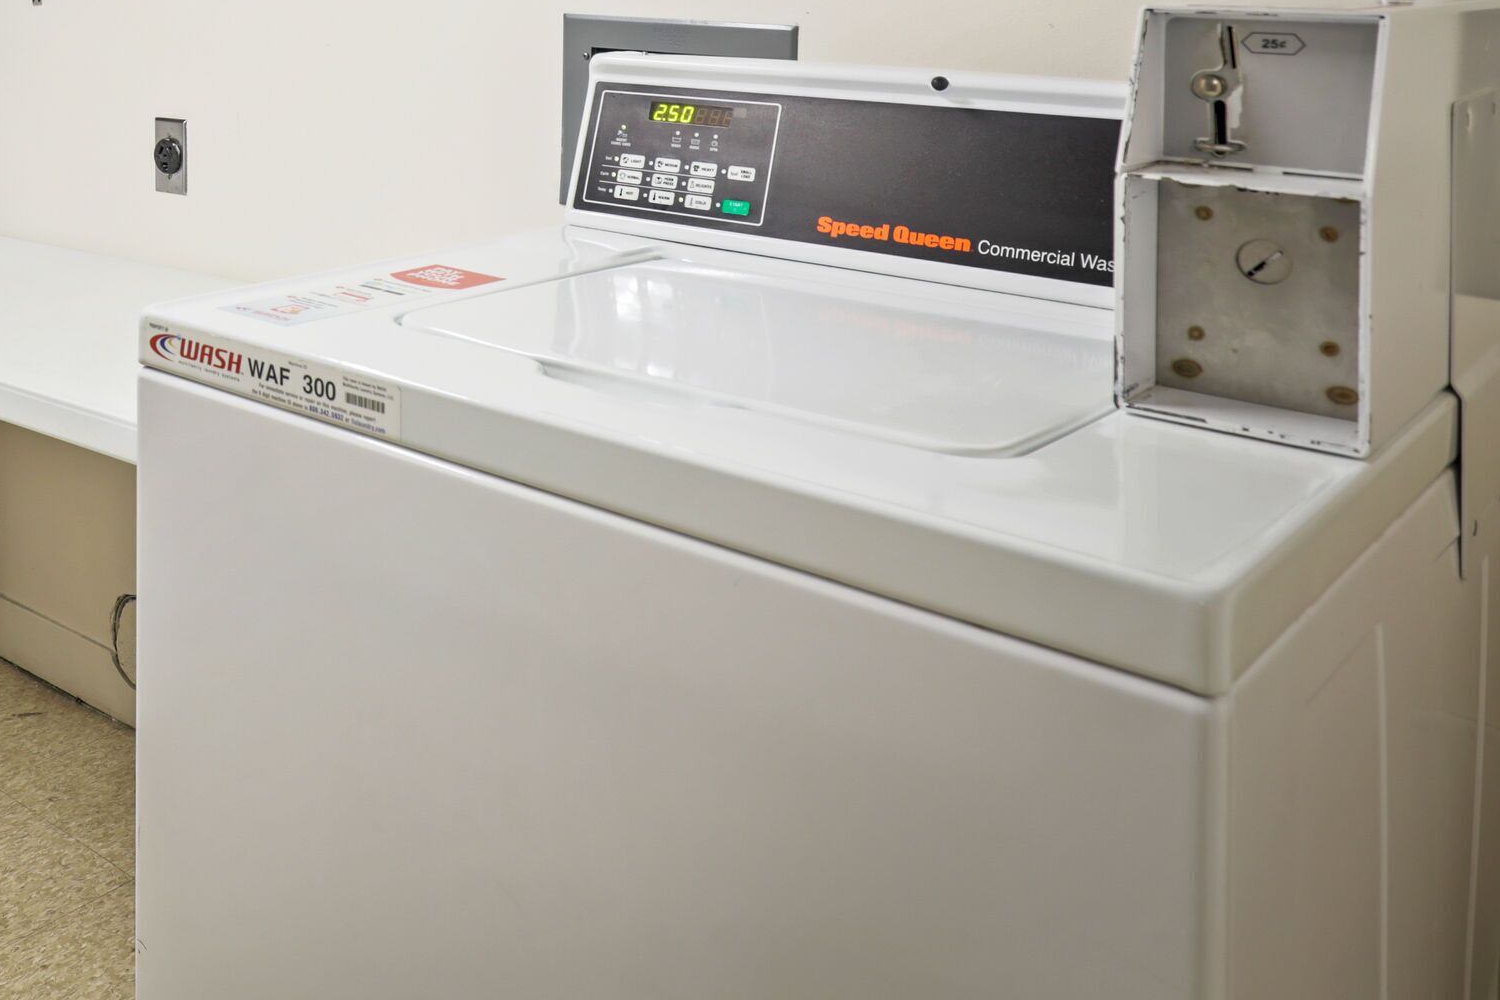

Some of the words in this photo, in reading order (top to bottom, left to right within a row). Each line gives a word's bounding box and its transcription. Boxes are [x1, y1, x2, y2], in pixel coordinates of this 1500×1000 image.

[652, 103, 695, 123] 2.50
[817, 215, 890, 242] Speed
[893, 225, 971, 252] Queen
[977, 239, 1075, 267] Commercial
[179, 338, 243, 375] WASH
[247, 357, 291, 386] WAF
[302, 374, 336, 401] 300
